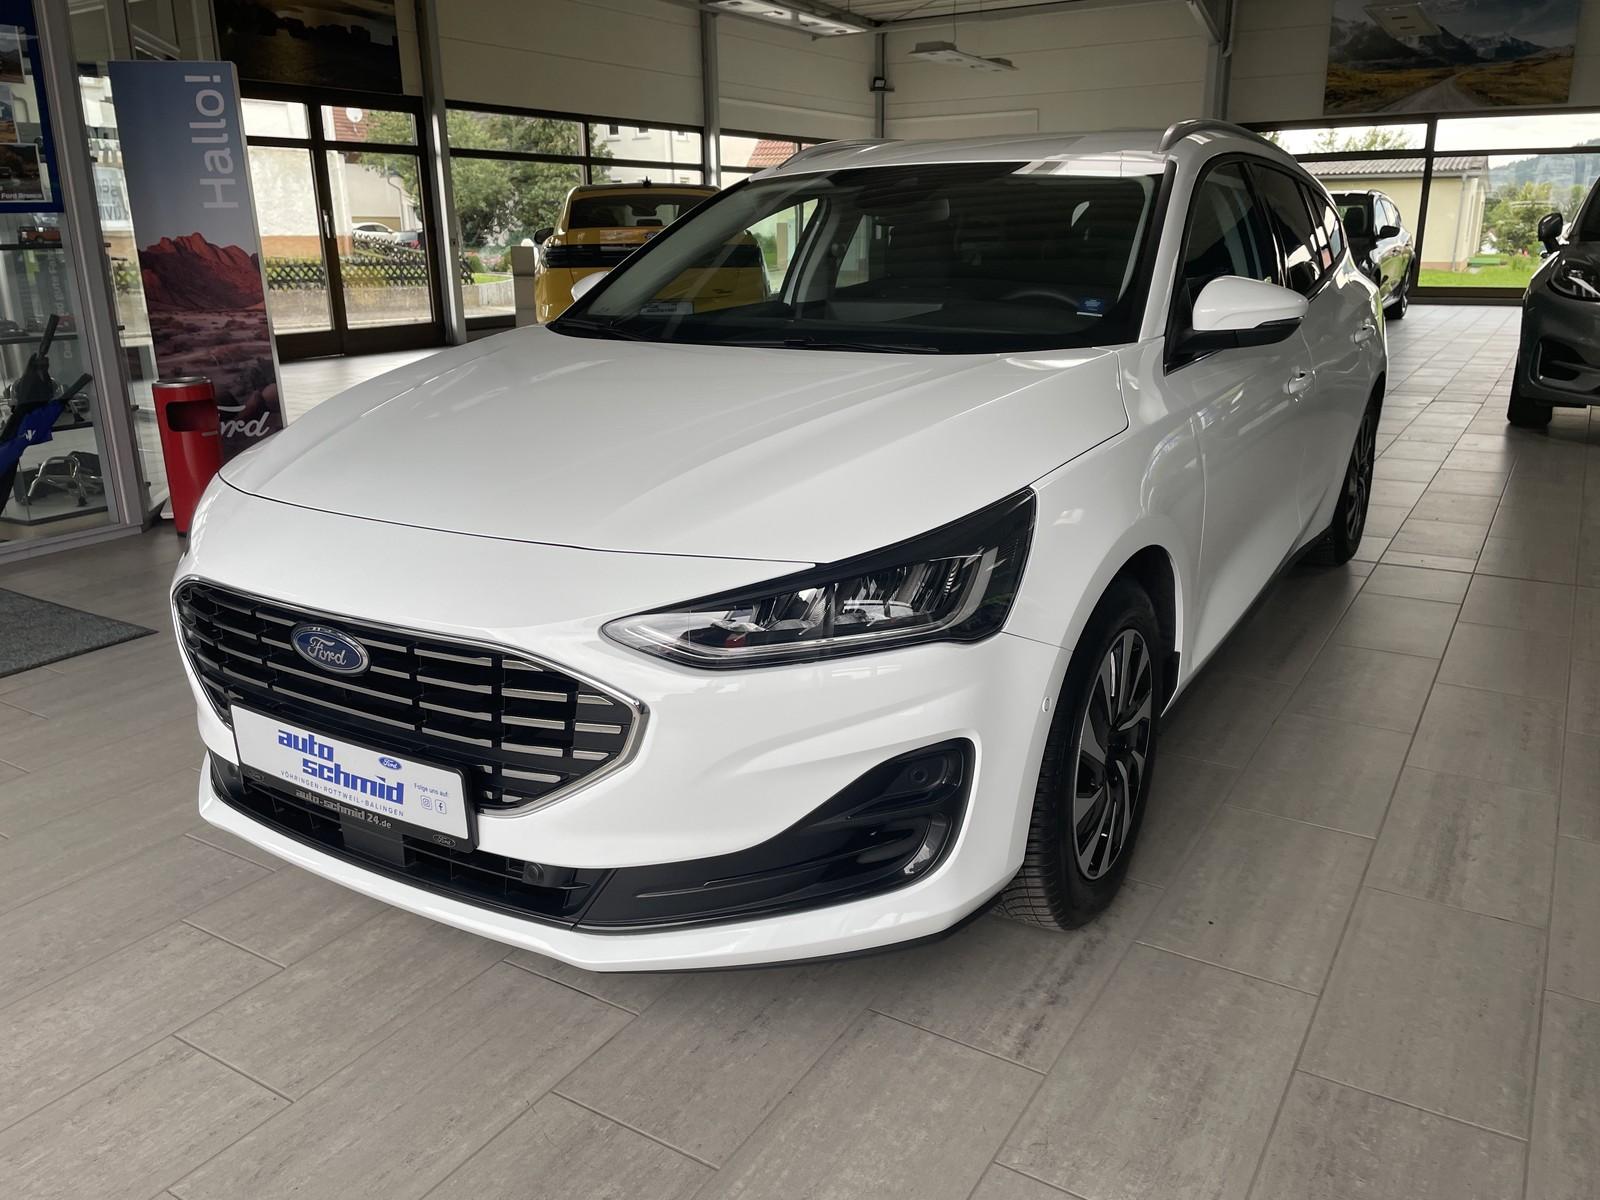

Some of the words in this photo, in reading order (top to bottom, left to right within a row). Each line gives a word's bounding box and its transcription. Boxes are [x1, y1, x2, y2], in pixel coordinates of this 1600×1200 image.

[184, 75, 239, 208] Hallo!
[307, 636, 347, 665] Ford
[278, 729, 334, 762] auto
[302, 758, 404, 805] schmid
